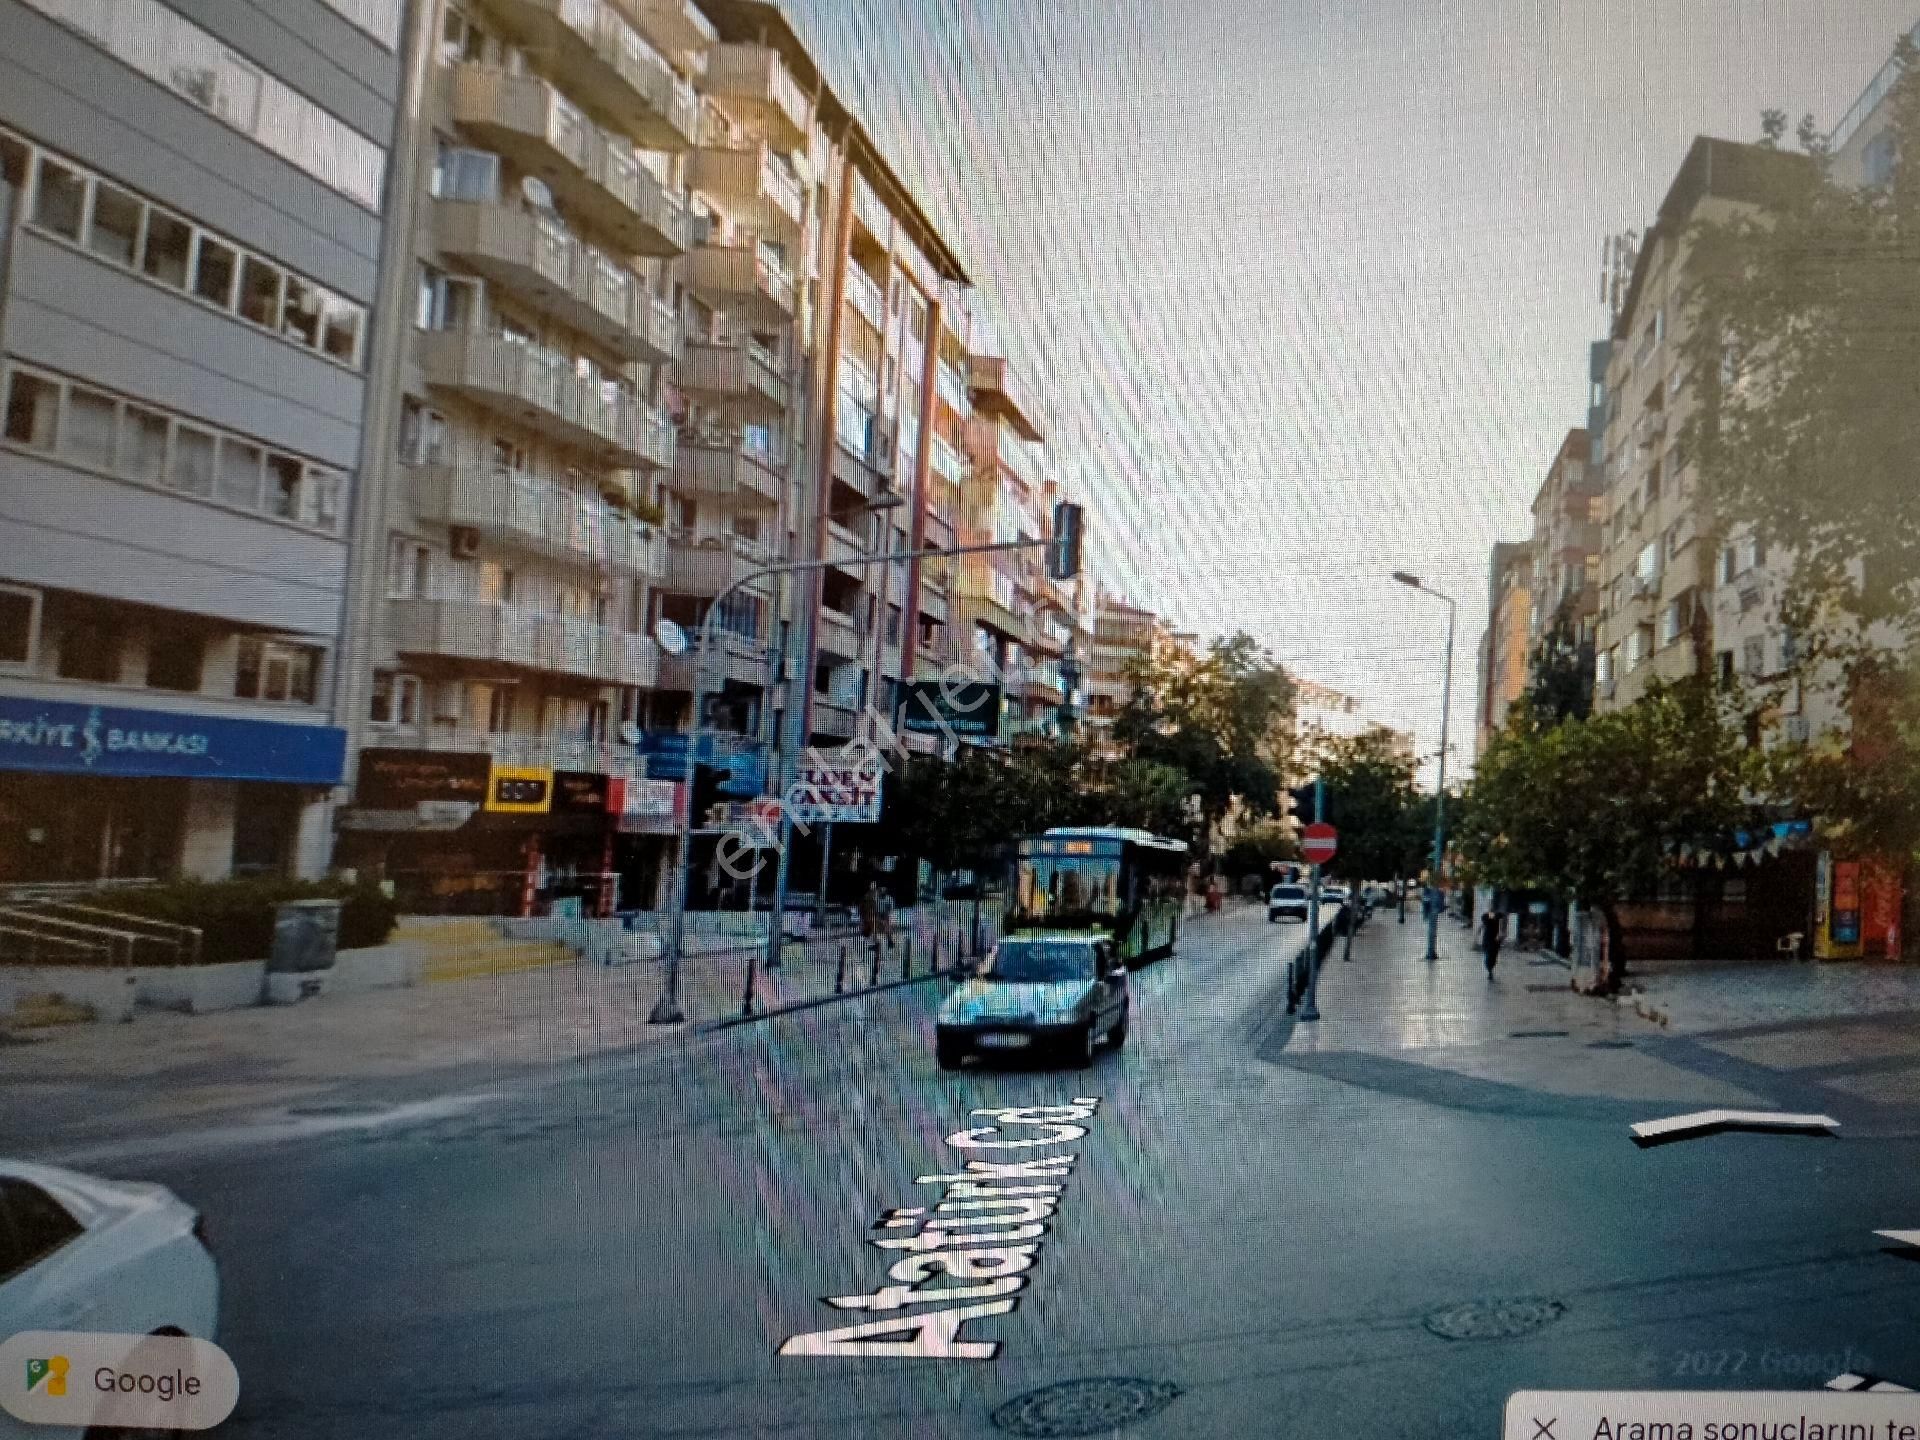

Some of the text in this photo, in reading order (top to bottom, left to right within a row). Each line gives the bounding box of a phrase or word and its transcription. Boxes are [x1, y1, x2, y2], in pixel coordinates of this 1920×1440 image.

[107, 727, 209, 755] BANKASI
[778, 1154, 1078, 1359] Atatürk
[94, 1367, 201, 1401] Google
[1594, 1416, 1693, 1440] Arama
[1886, 1418, 1920, 1440] te
